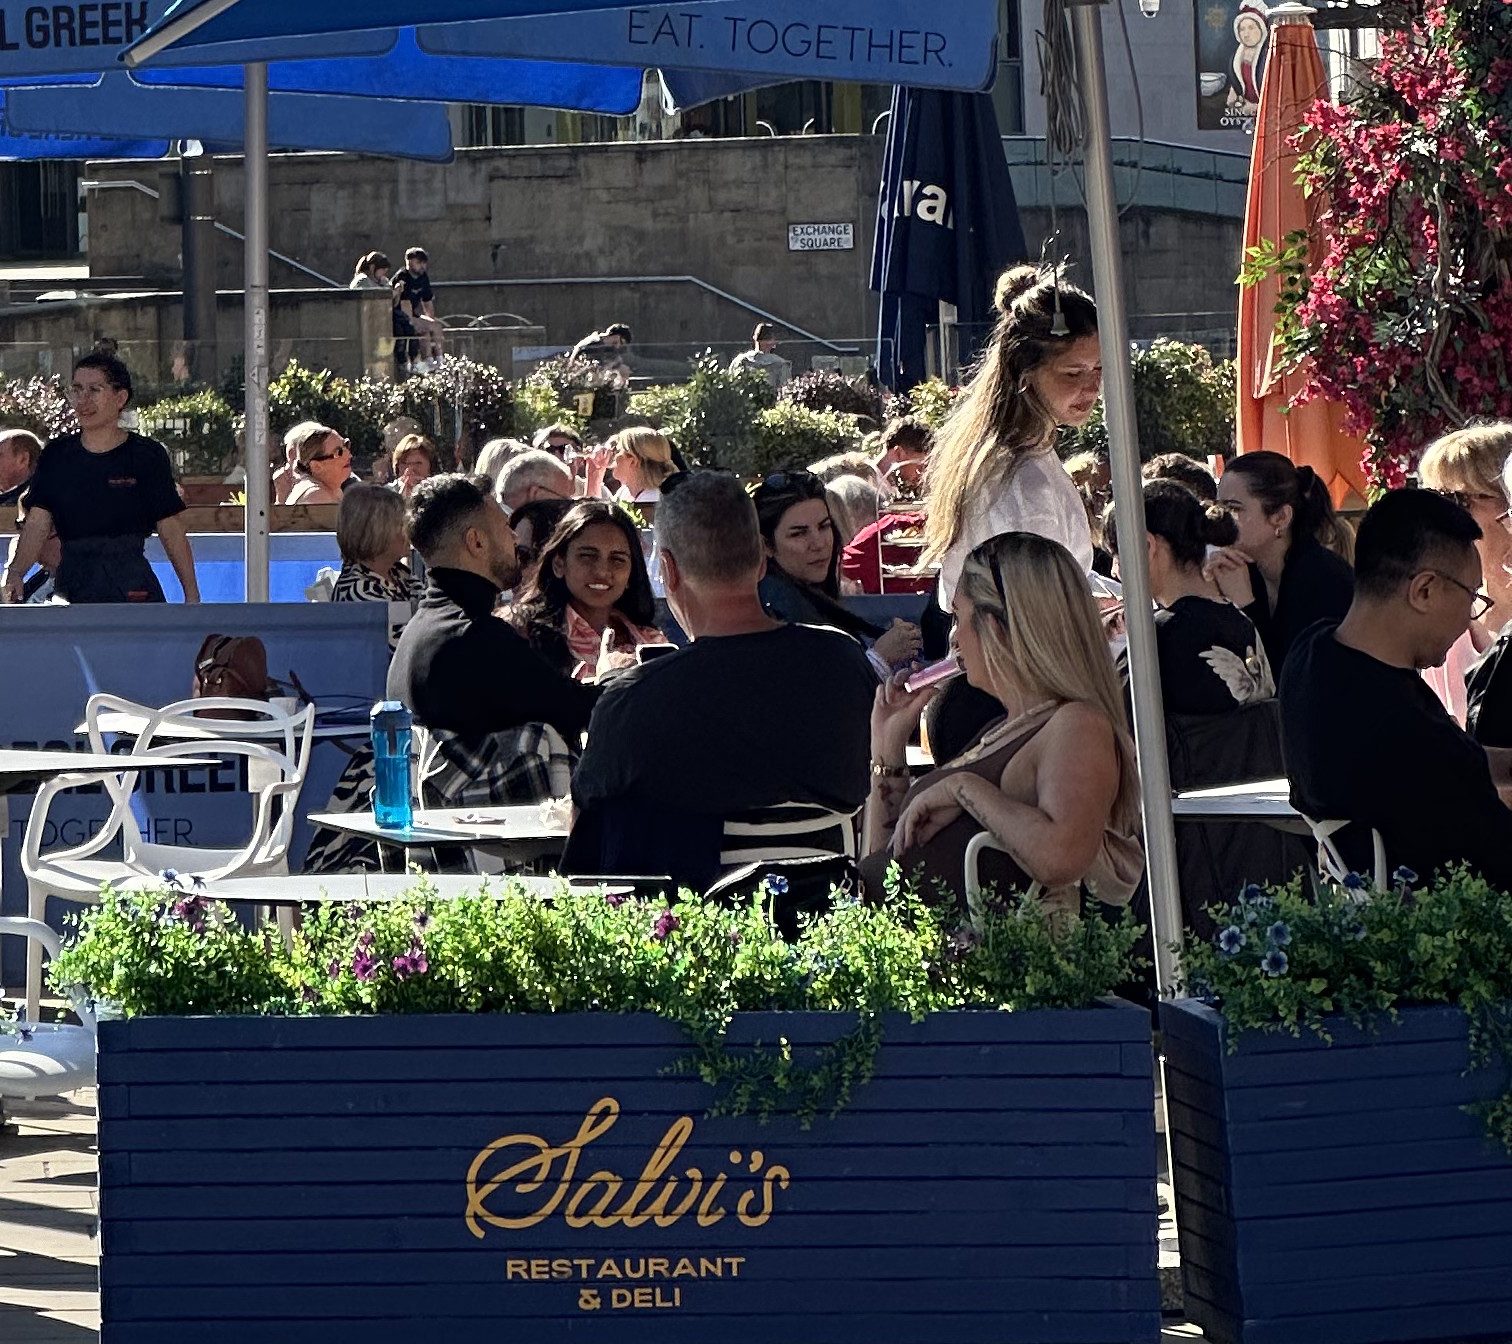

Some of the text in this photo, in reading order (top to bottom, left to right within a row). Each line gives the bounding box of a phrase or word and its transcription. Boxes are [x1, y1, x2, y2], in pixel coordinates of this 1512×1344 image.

[26, 0, 149, 48] GREEK
[628, 10, 954, 68] EAT. TOGETHER.
[792, 224, 850, 236] EXCHANGE
[799, 237, 844, 249] SQUARE
[464, 1096, 791, 1240] Salvi's
[506, 1256, 746, 1280] RESTAURANT
[577, 1287, 682, 1311] & DELI
